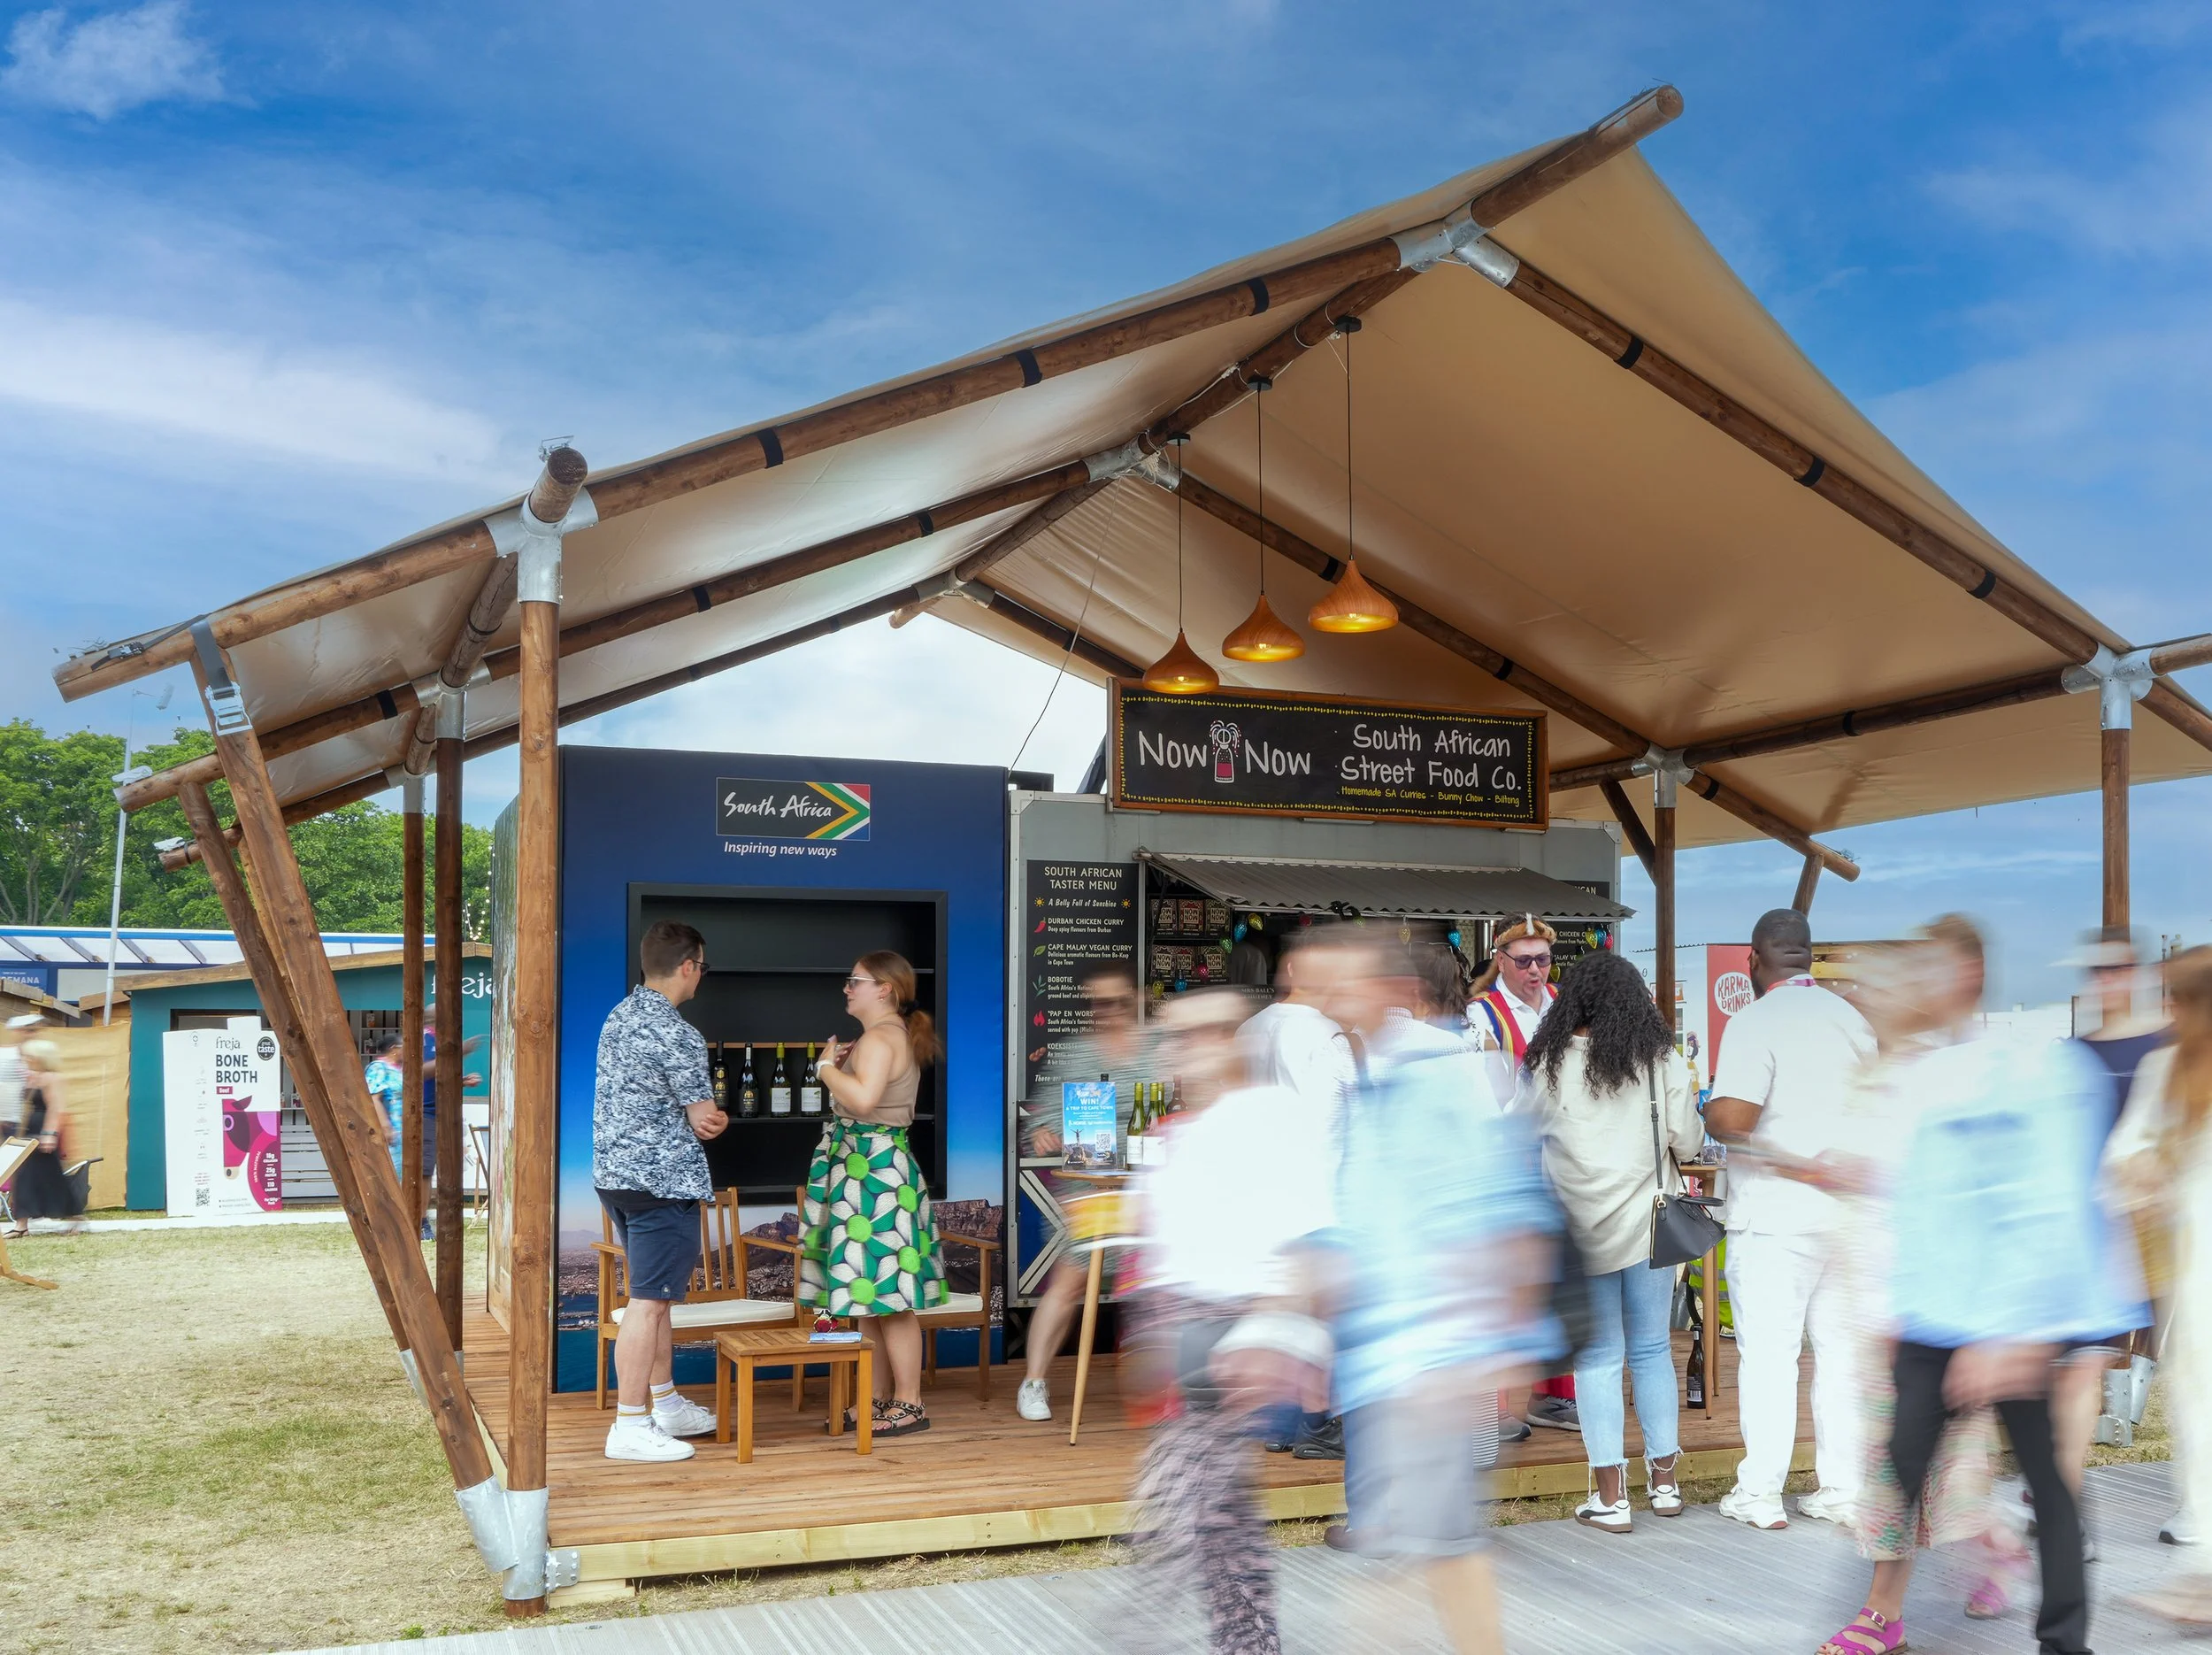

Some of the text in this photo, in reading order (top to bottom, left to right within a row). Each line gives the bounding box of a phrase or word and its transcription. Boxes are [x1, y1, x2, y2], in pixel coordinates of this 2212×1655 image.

[1353, 723, 1510, 758] South African
[1340, 755, 1521, 790] Street Food Co.
[1341, 786, 1381, 797] Homemade
[1385, 789, 1396, 797] SA
[1400, 789, 1426, 799] Curries
[1438, 791, 1462, 804] Bunny
[1465, 792, 1483, 803] Chow
[1495, 795, 1520, 807] Biltong
[724, 792, 832, 819] South Africa
[724, 842, 837, 858] Inspiring new ways
[1044, 866, 1122, 878] SOUTH AFRICAN
[1049, 880, 1117, 890] TASTER MENU
[1056, 898, 1070, 908] Belly
[1718, 975, 1750, 1000] KARMA
[216, 1036, 241, 1051] freja
[216, 1055, 249, 1066] BONE
[216, 1071, 257, 1083] BROTH
